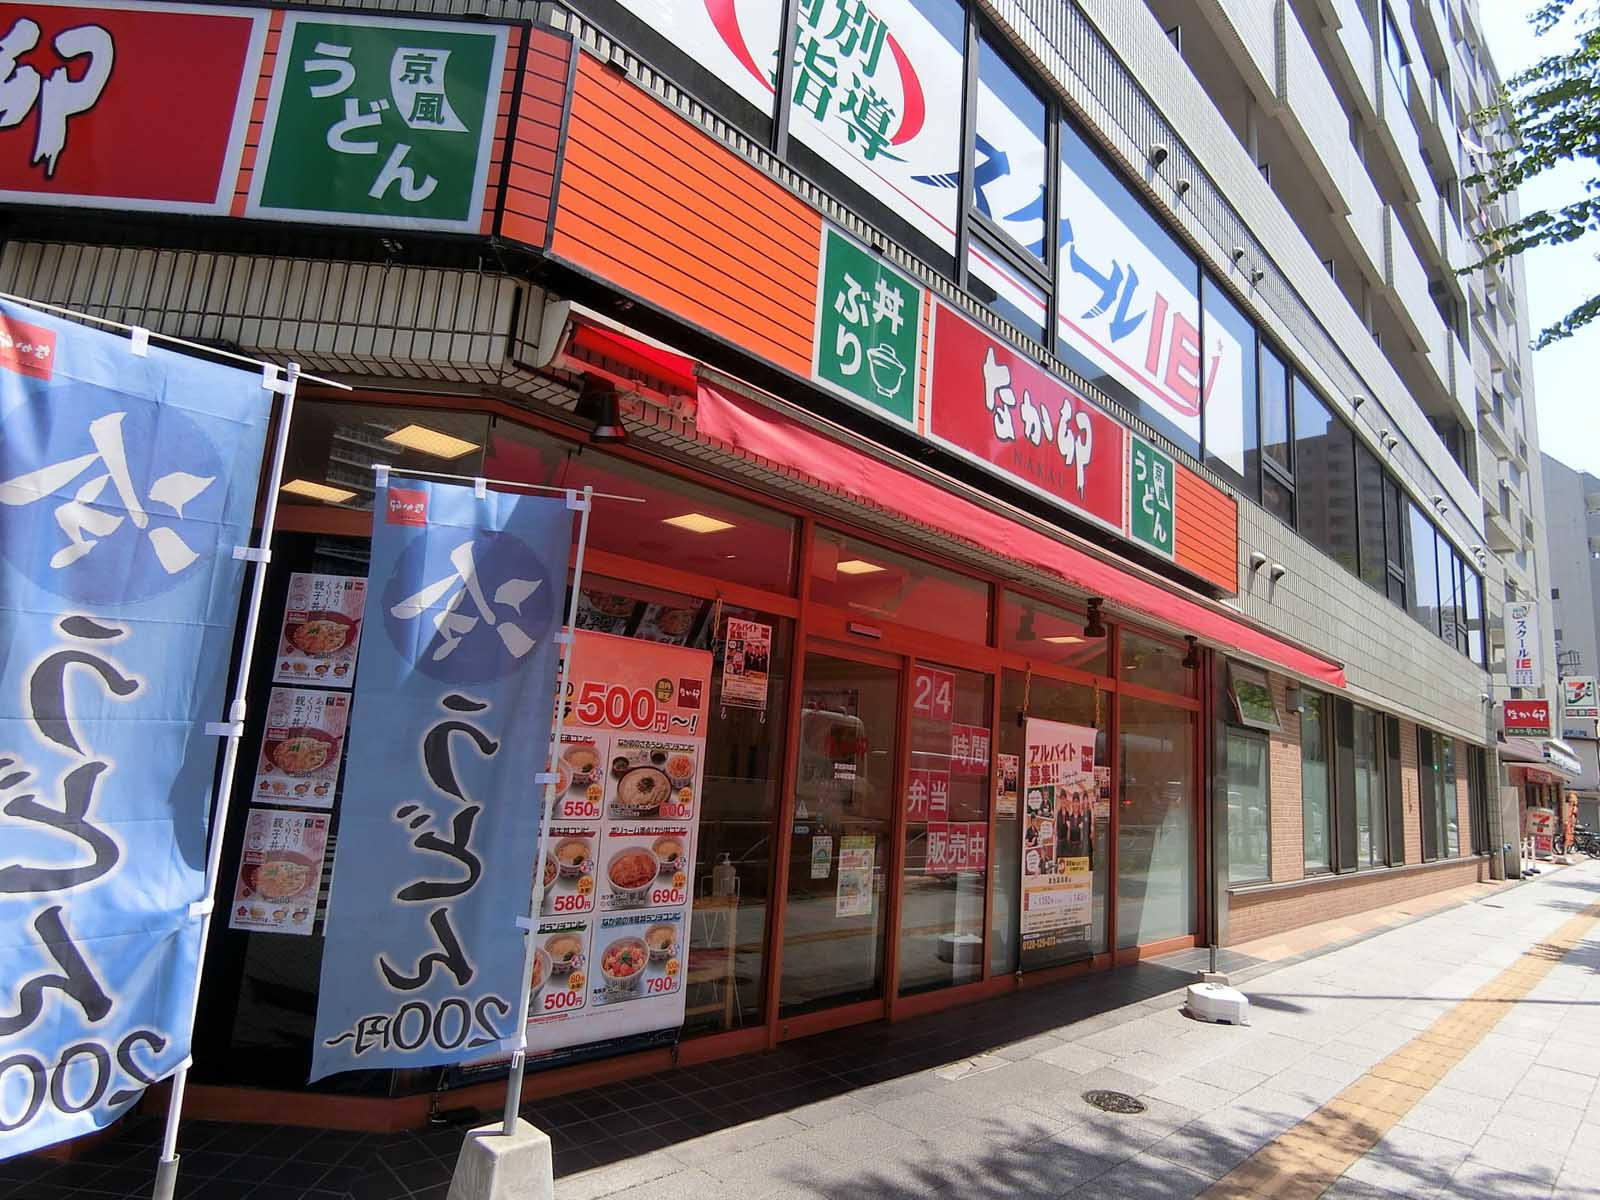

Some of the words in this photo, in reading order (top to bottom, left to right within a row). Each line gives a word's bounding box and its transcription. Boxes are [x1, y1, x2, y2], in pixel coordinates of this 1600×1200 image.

[399, 53, 445, 125] 京風
[768, 36, 910, 162] 指導
[304, 42, 438, 202] うどん
[982, 346, 1093, 500] なか卯
[1014, 449, 1065, 490] NAKAU
[1135, 450, 1167, 543] うどん
[913, 675, 952, 715] 24
[1507, 709, 1546, 721] なか卯
[951, 734, 988, 768] 時間
[1029, 742, 1076, 763] アルバイト
[564, 801, 600, 817] 550円
[907, 779, 947, 813] 弁当
[927, 832, 986, 864] 販売中
[554, 895, 591, 911] 580円
[652, 888, 684, 904] 690円
[544, 991, 583, 1010] 500円
[647, 976, 677, 994] 790円
